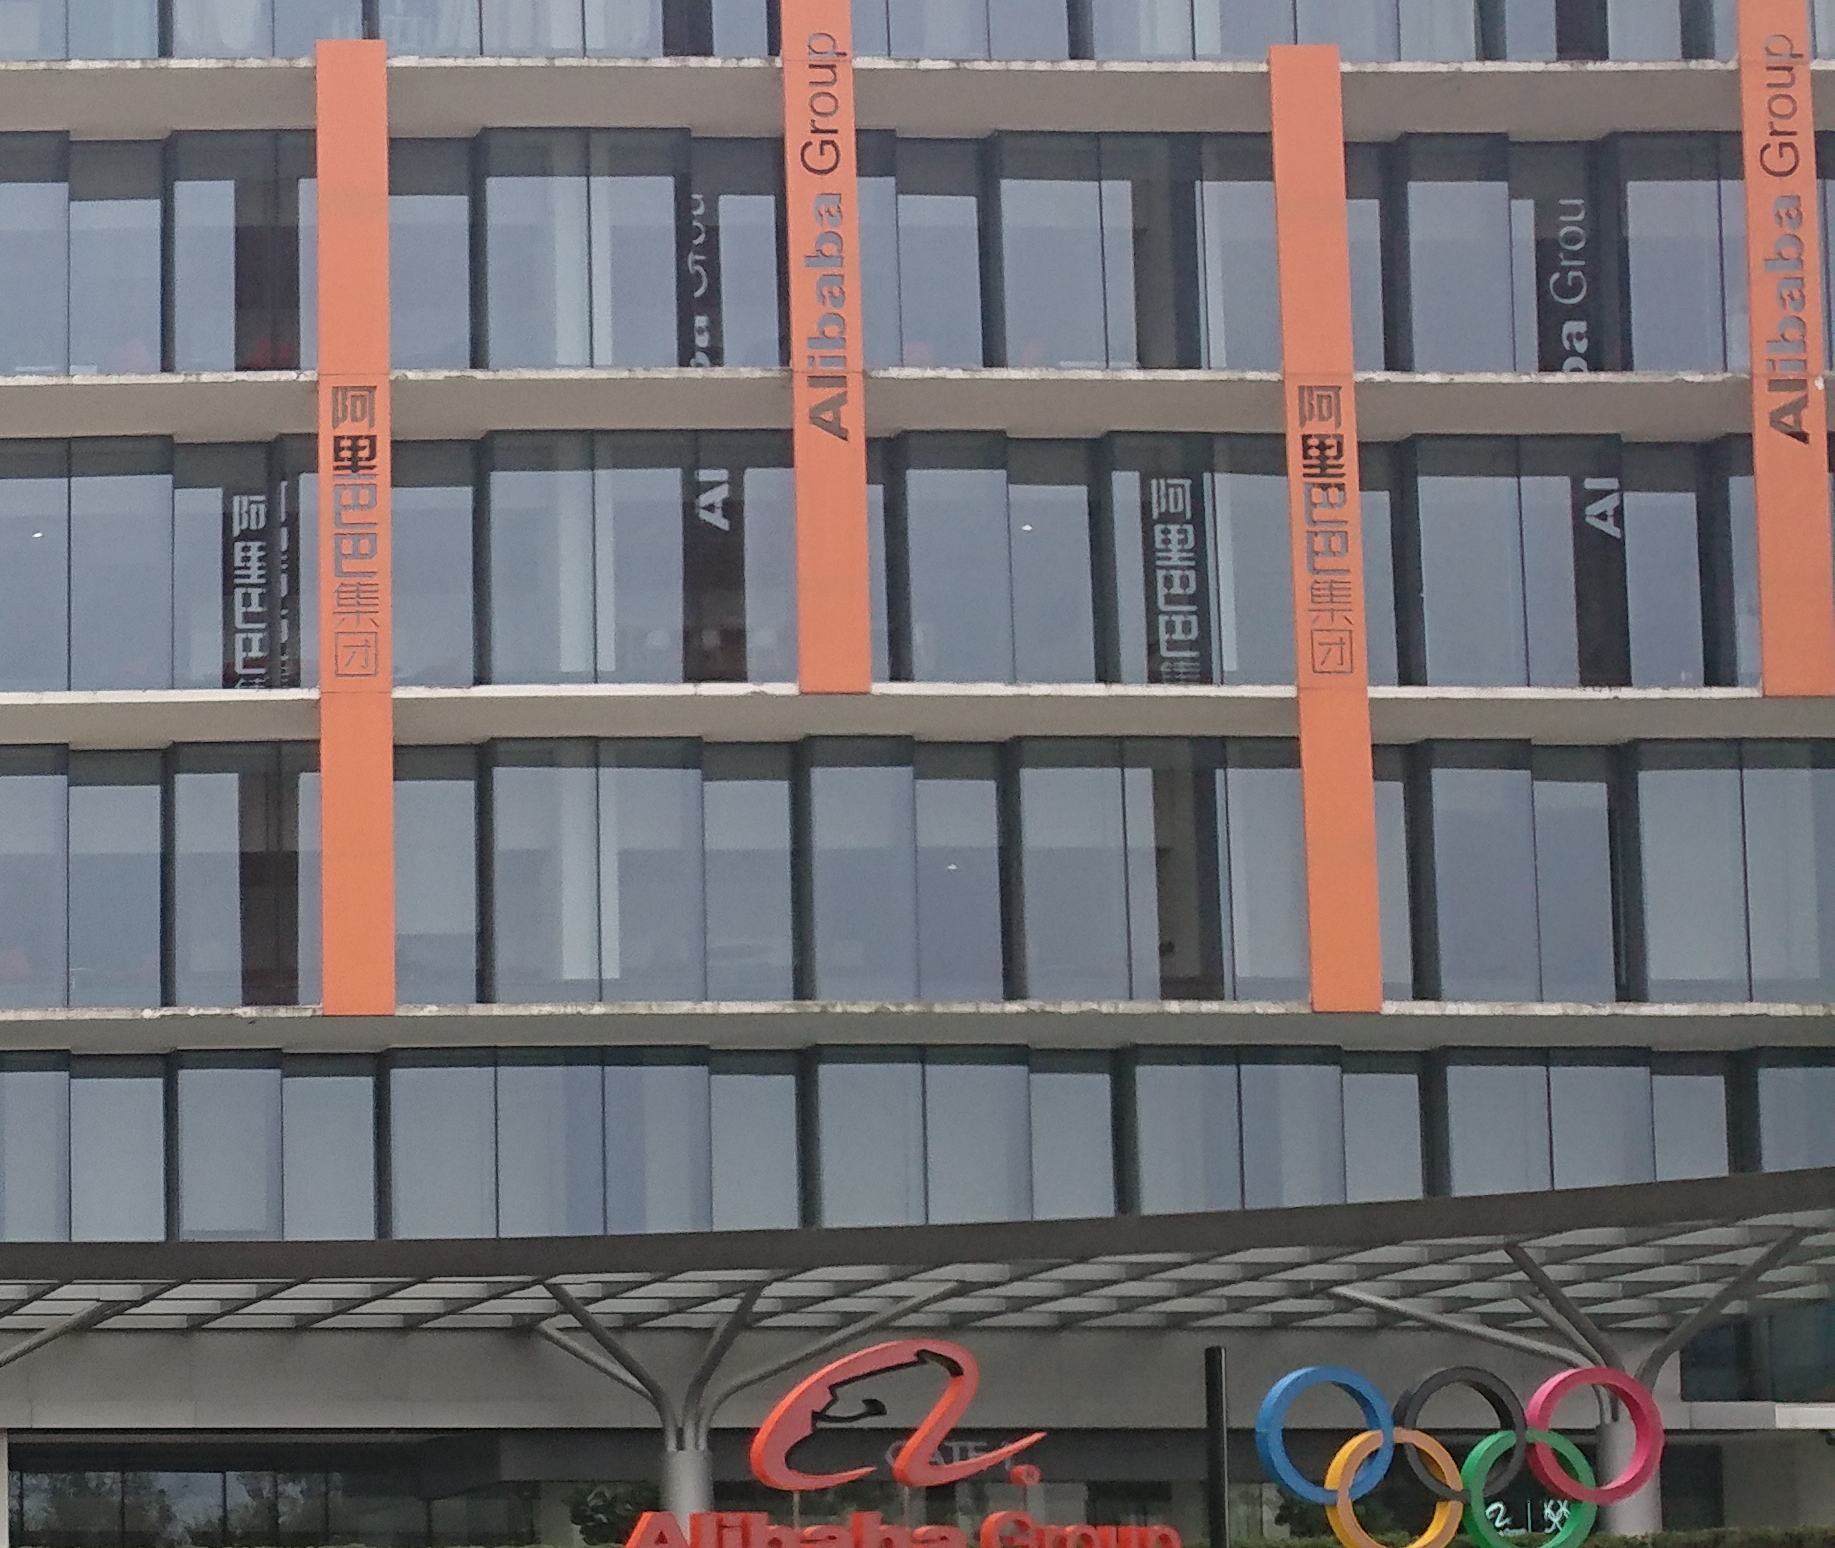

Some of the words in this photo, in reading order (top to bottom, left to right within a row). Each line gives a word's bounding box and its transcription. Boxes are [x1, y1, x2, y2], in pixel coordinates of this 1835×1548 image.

[800, 30, 848, 177] Group
[1759, 32, 1804, 179] Group
[807, 192, 851, 442] Alibaba
[1764, 193, 1812, 445] Alibaba
[332, 385, 379, 678] 阿里巴巴集团
[1297, 384, 1354, 675] 阿里巴巴集团
